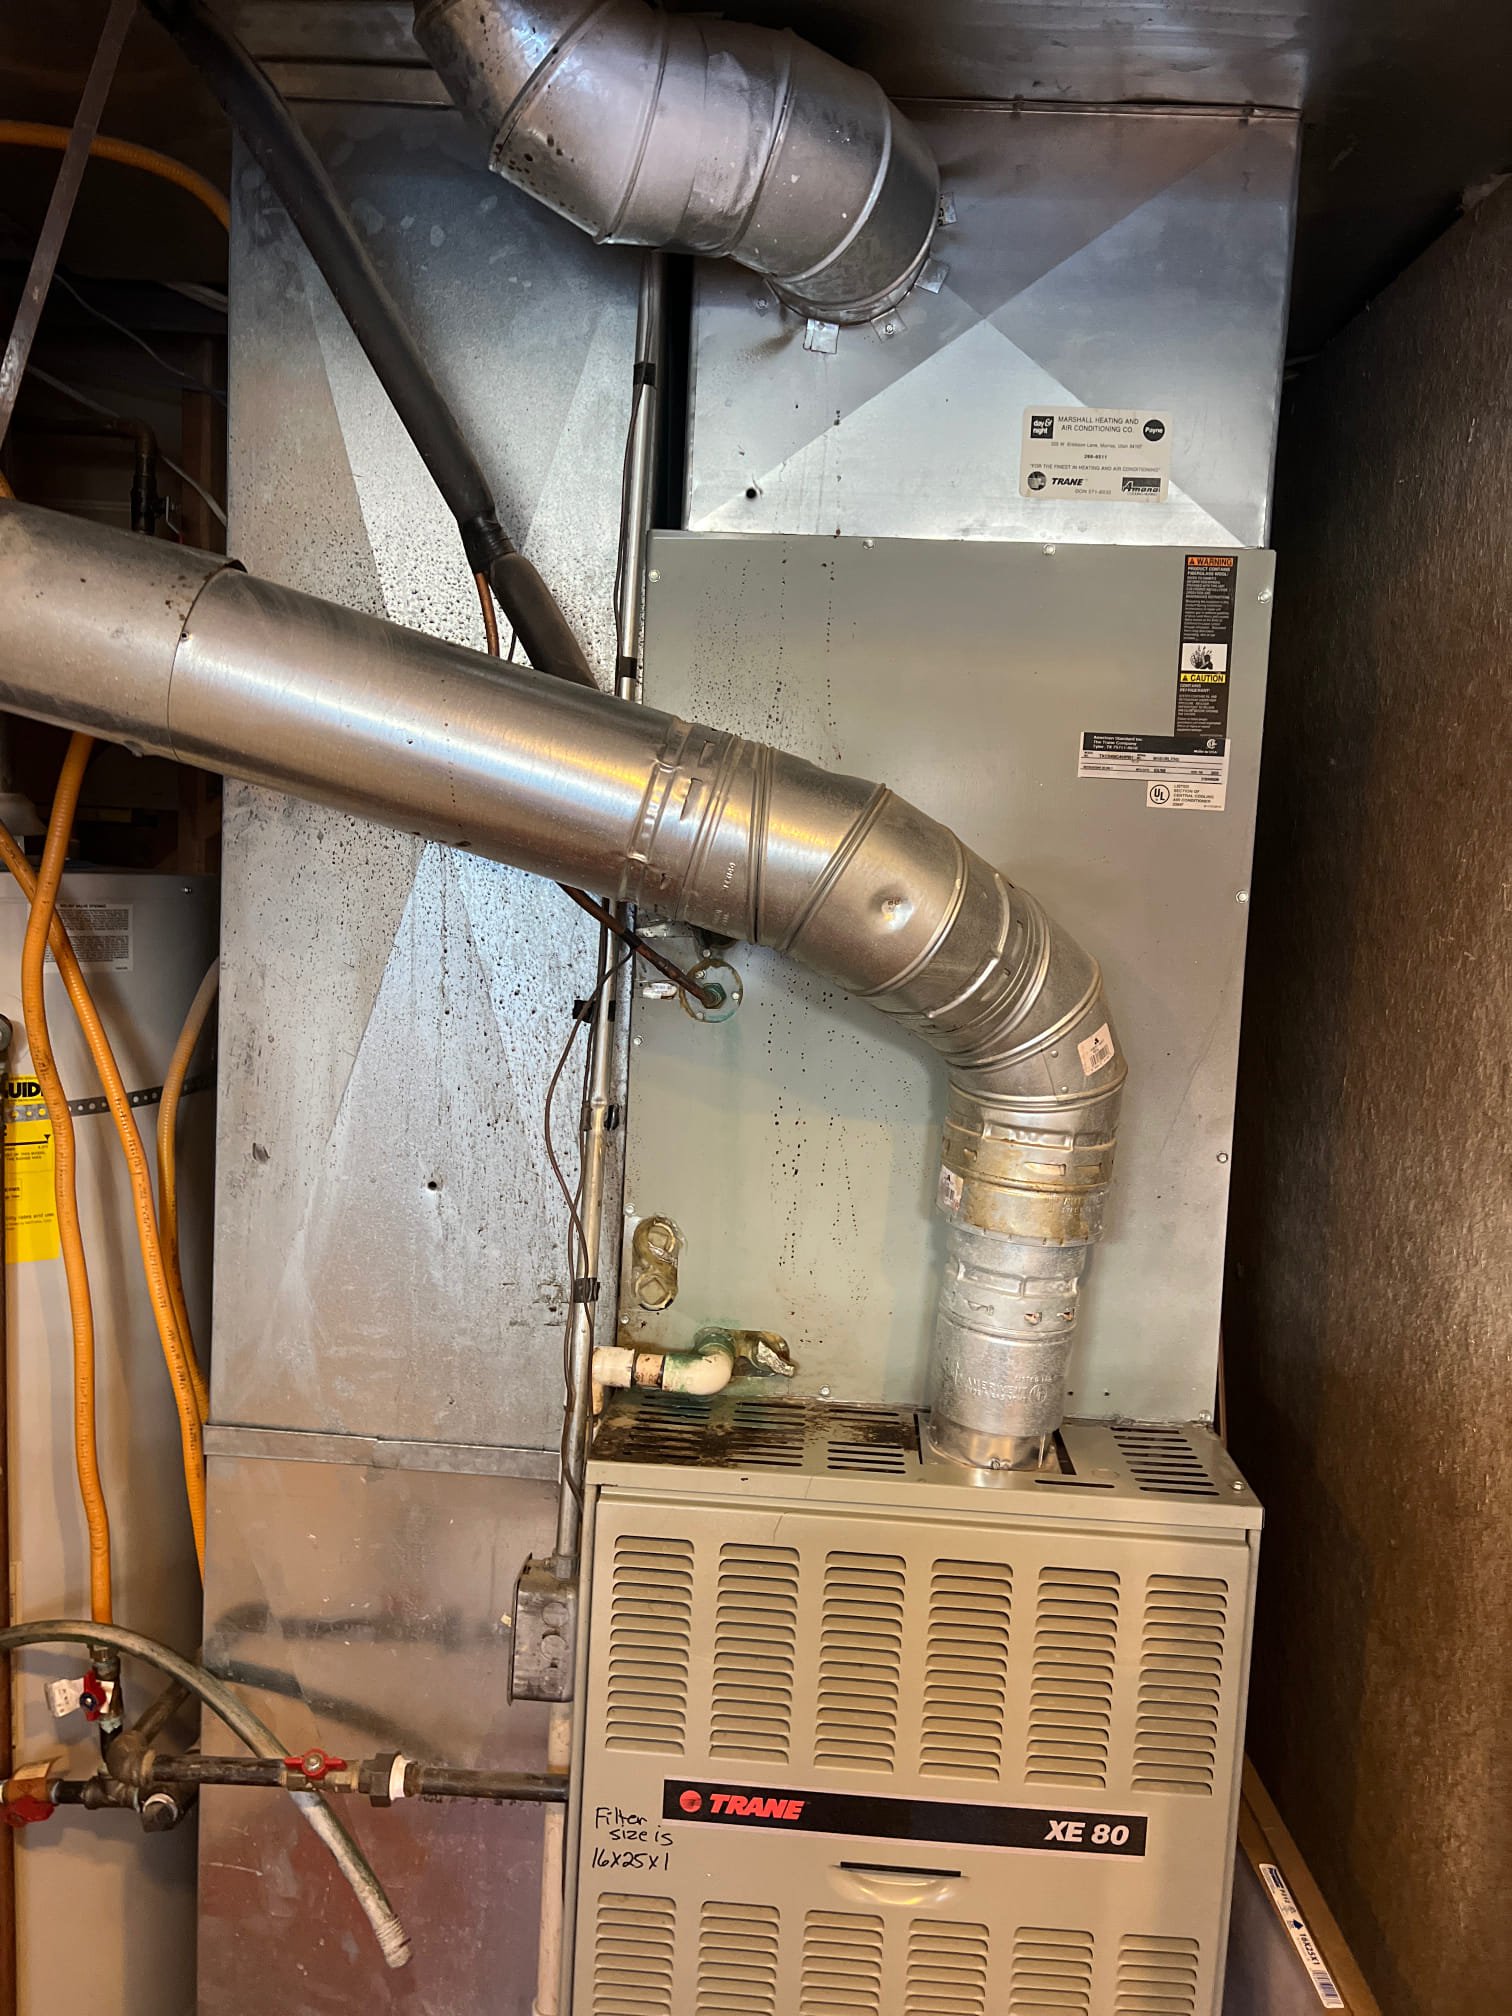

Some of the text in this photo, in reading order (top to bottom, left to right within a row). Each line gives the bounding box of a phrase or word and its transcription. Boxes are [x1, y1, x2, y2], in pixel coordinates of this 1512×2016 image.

[1095, 416, 1122, 424] HEATING
[1075, 425, 1121, 433] CONDITIONING
[1144, 426, 1163, 434] Payne
[1052, 478, 1084, 486] TRANE
[1196, 557, 1232, 566] WARNING
[1190, 674, 1224, 682] CAUTION
[1154, 788, 1165, 800] UL
[708, 1793, 805, 1821] TRANE
[596, 1806, 648, 1829] Filter
[609, 1824, 674, 1846] size is
[1044, 1820, 1130, 1846] XE 80
